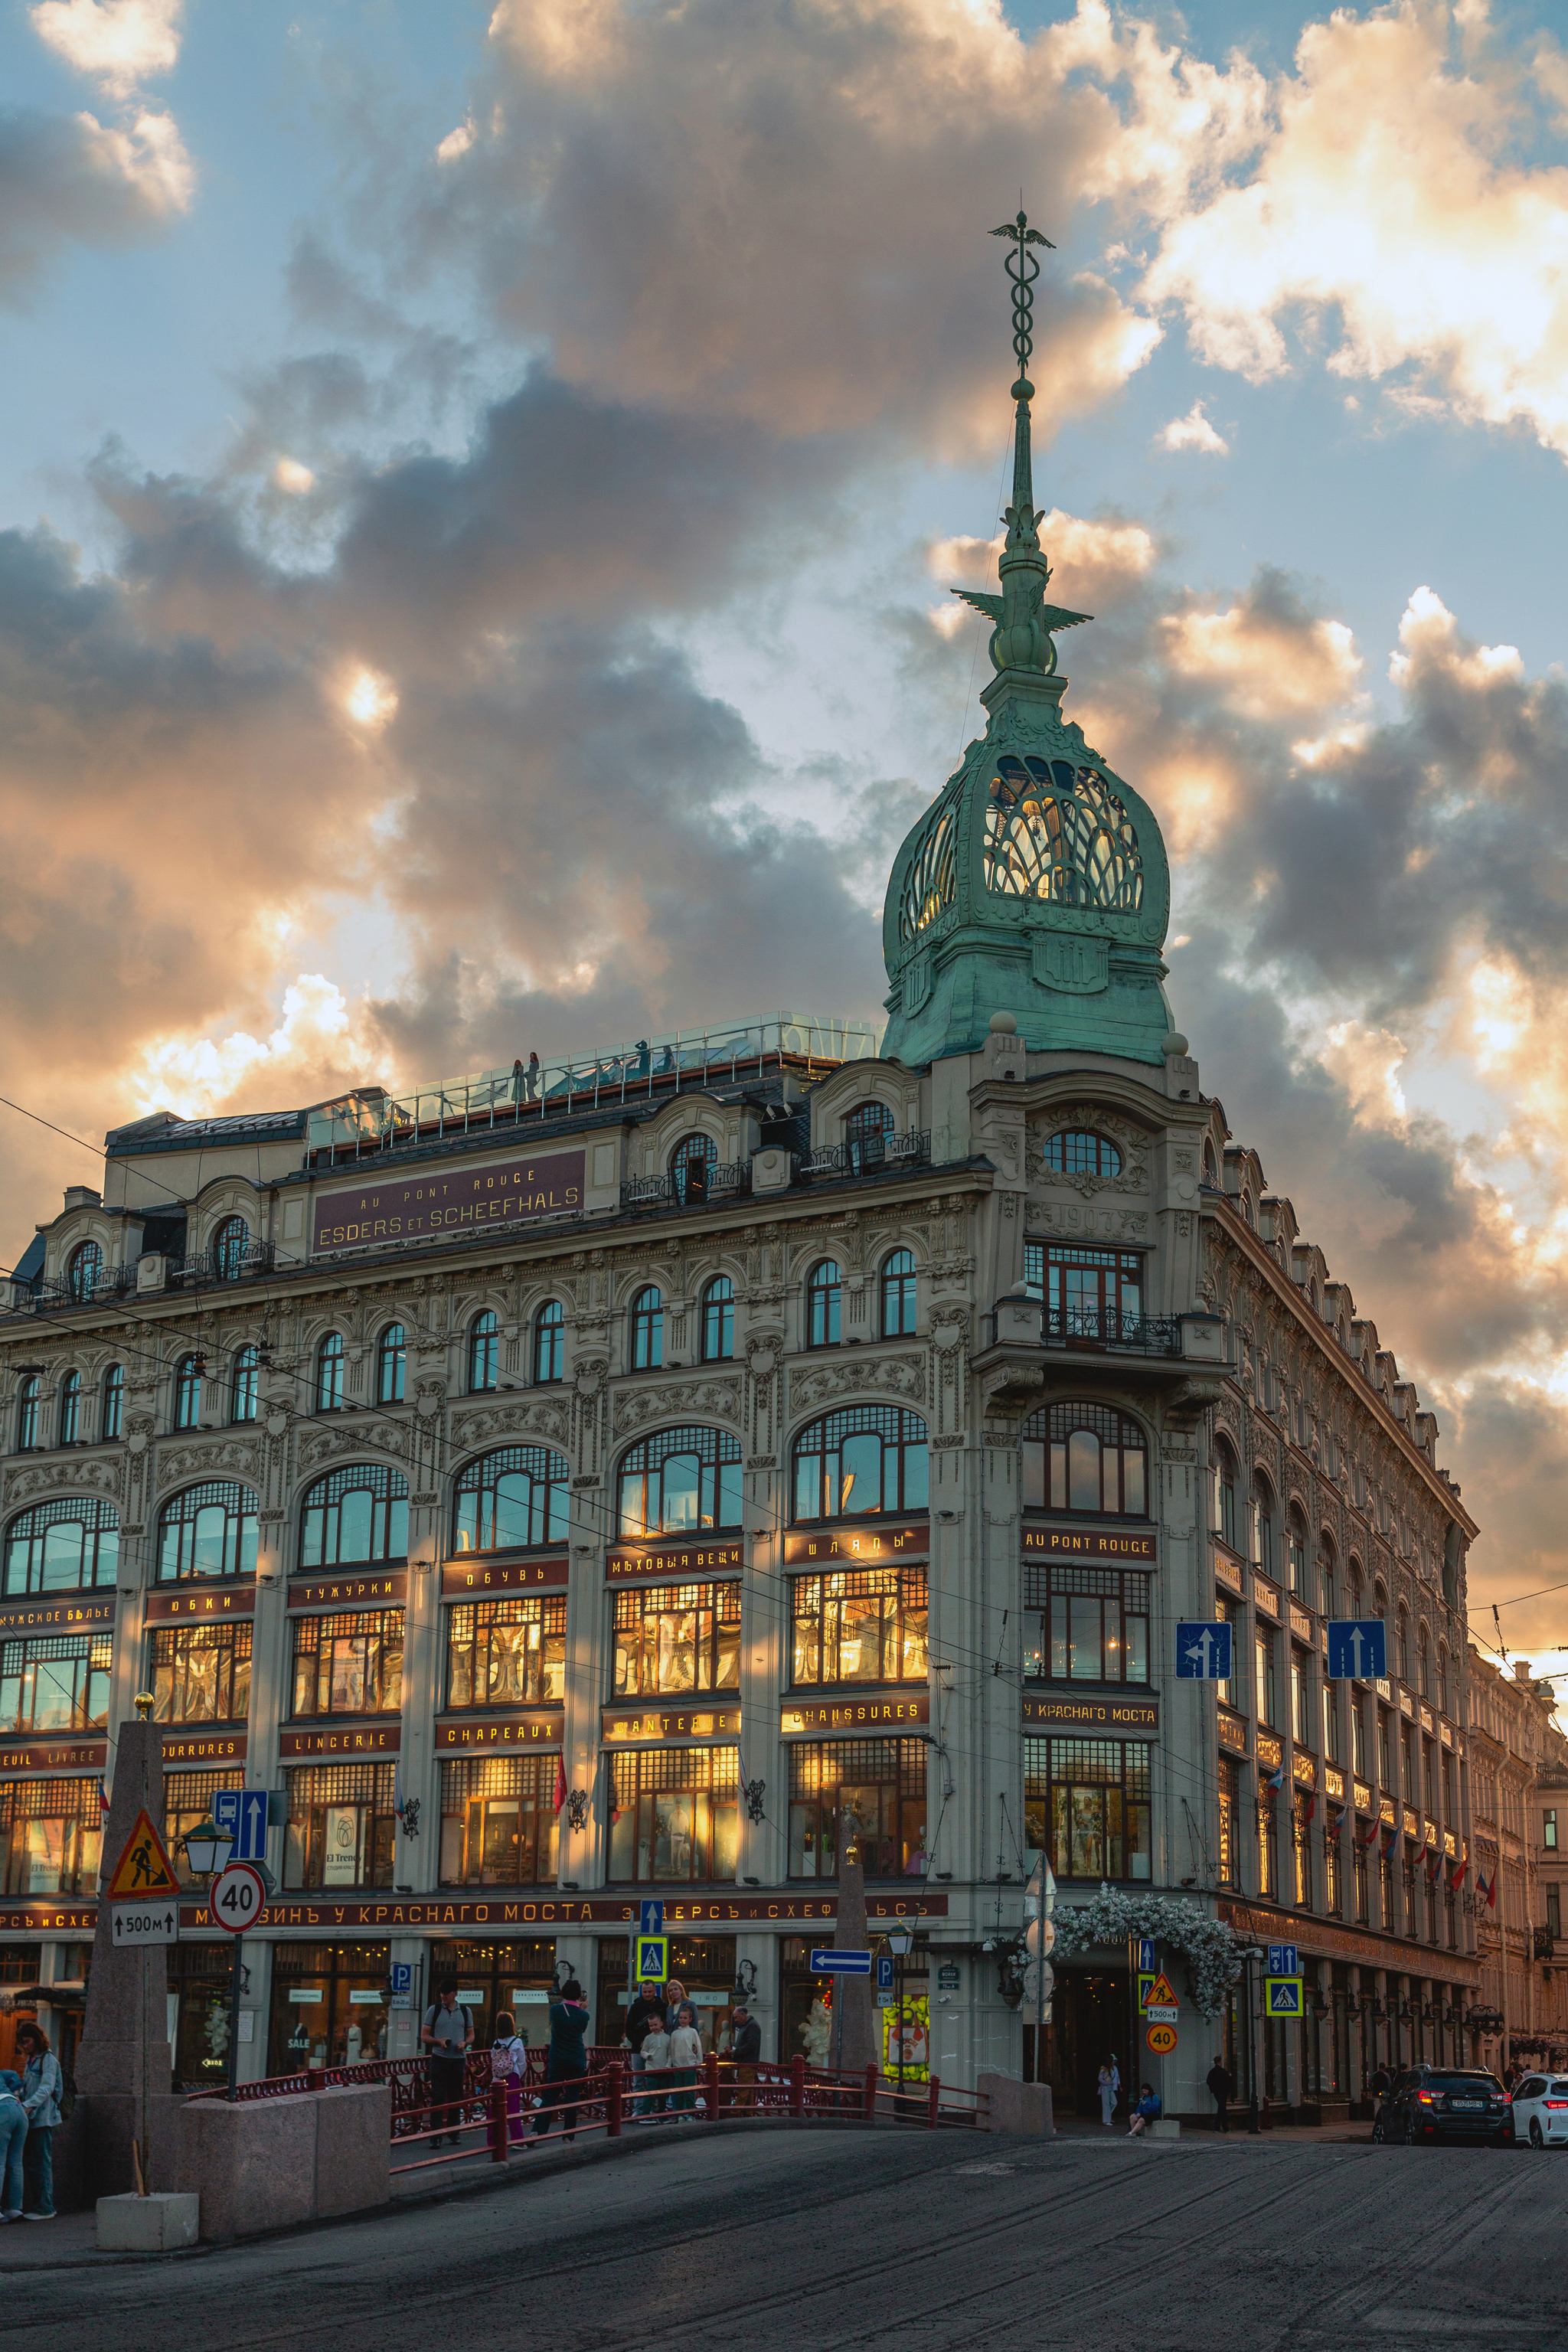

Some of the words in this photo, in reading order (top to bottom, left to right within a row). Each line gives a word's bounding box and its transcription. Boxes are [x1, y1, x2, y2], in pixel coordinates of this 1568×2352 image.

[361, 1197, 380, 1210] AU
[404, 1185, 449, 1202] PONT
[473, 1170, 535, 1190] ROUGE
[319, 1217, 402, 1246] ESDERS
[407, 1217, 423, 1231] ET
[430, 1187, 579, 1227] SCHEEFHALS
[808, 1535, 904, 1555] ШЛЯПЫ
[1026, 1534, 1044, 1546] AU
[1051, 1535, 1091, 1549] PONT
[1099, 1539, 1150, 1553] ROUGE
[697, 1550, 738, 1565] ВЕЩИ
[466, 1569, 544, 1586] ОБУВЬ
[305, 1582, 392, 1599] ТУЖУРКИ
[172, 1597, 230, 1612] ЮБКИ
[793, 1704, 918, 1723] CHAUSSURES
[1024, 1704, 1031, 1716] У
[1038, 1704, 1106, 1720] КРАСНАГО
[1112, 1708, 1155, 1723] МОСТА
[448, 1724, 552, 1742] CHAPEAUX
[221, 1884, 253, 1912] 40
[195, 1908, 319, 1924] МЗИНЪ
[335, 1907, 345, 1922] У
[359, 1905, 488, 1923] КРАСНАГО
[505, 1903, 593, 1922] МОСТА
[397, 1967, 408, 1988] P
[882, 1961, 891, 1984] P
[288, 2039, 310, 2049] SALE
[1152, 2033, 1171, 2045] 40
